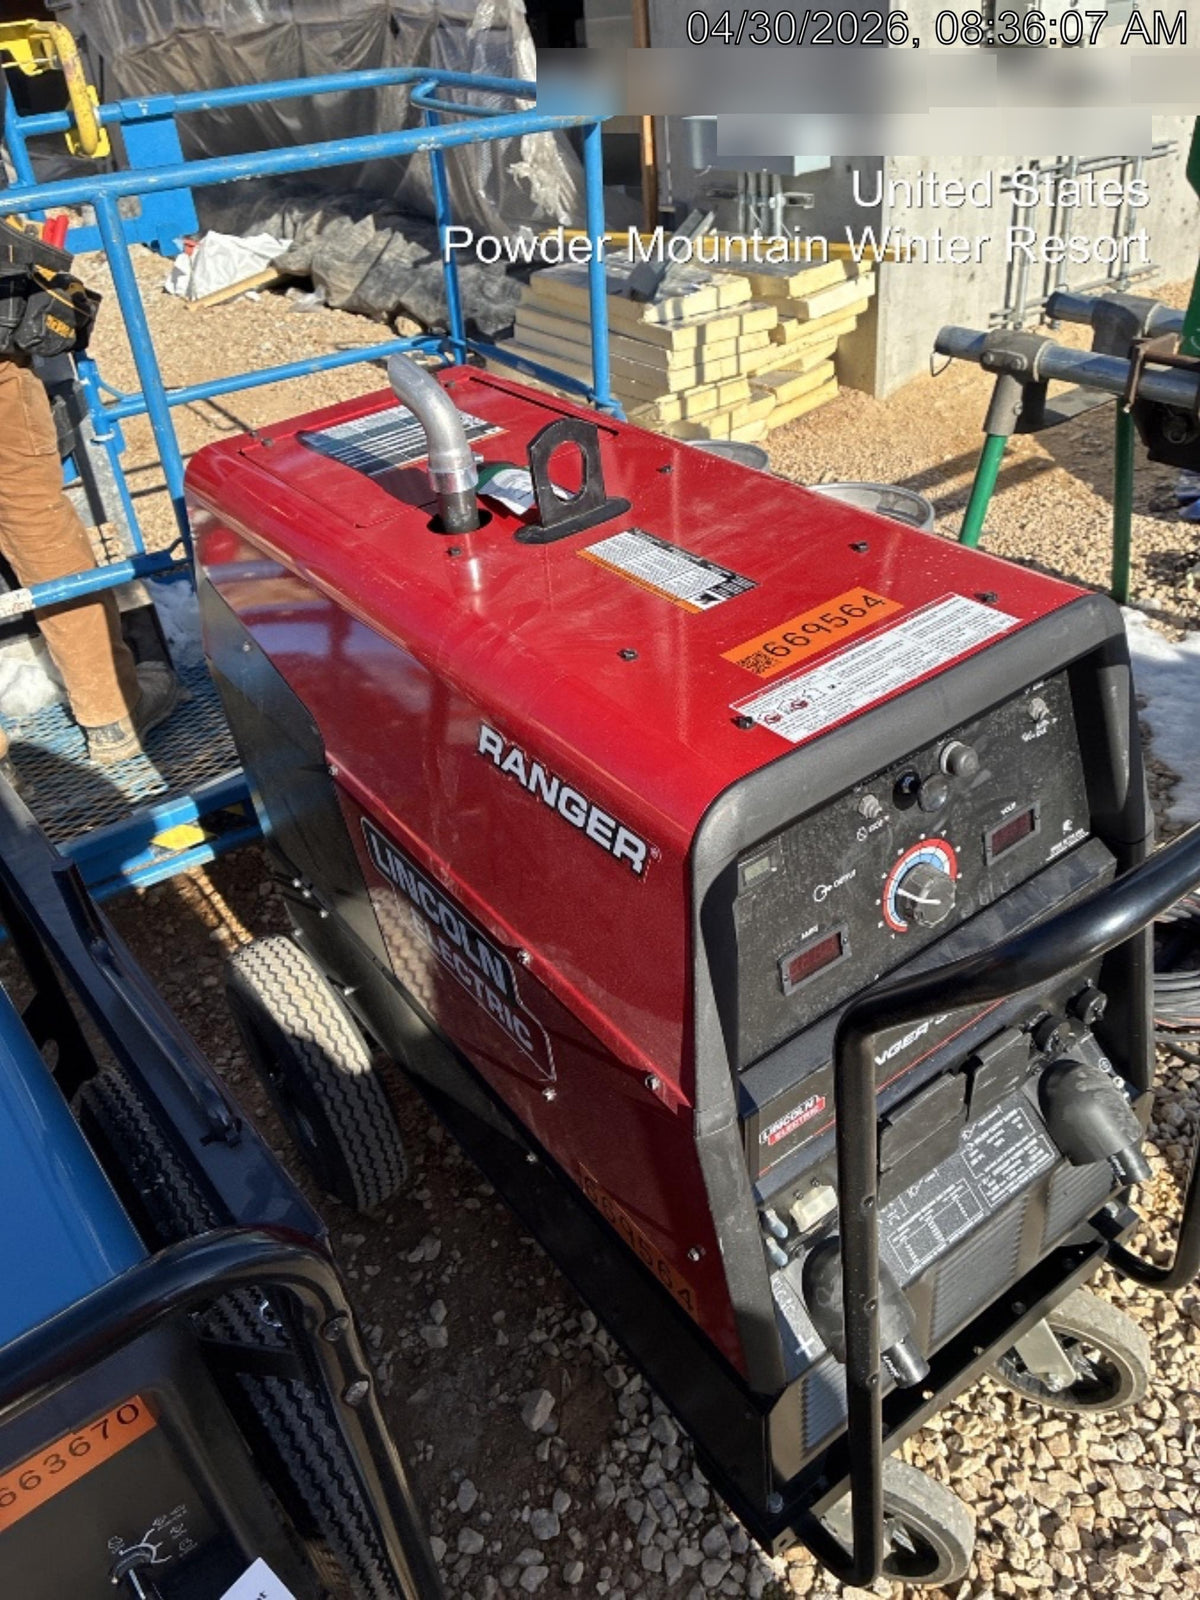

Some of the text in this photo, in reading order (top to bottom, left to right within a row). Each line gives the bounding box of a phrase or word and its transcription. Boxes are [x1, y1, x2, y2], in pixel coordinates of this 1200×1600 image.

[762, 594, 886, 657] 669564
[477, 724, 647, 874] RANGER
[370, 832, 509, 996] LINCOLN
[410, 907, 535, 1053] ELECTRIC
[0, 1402, 140, 1509] 663670
